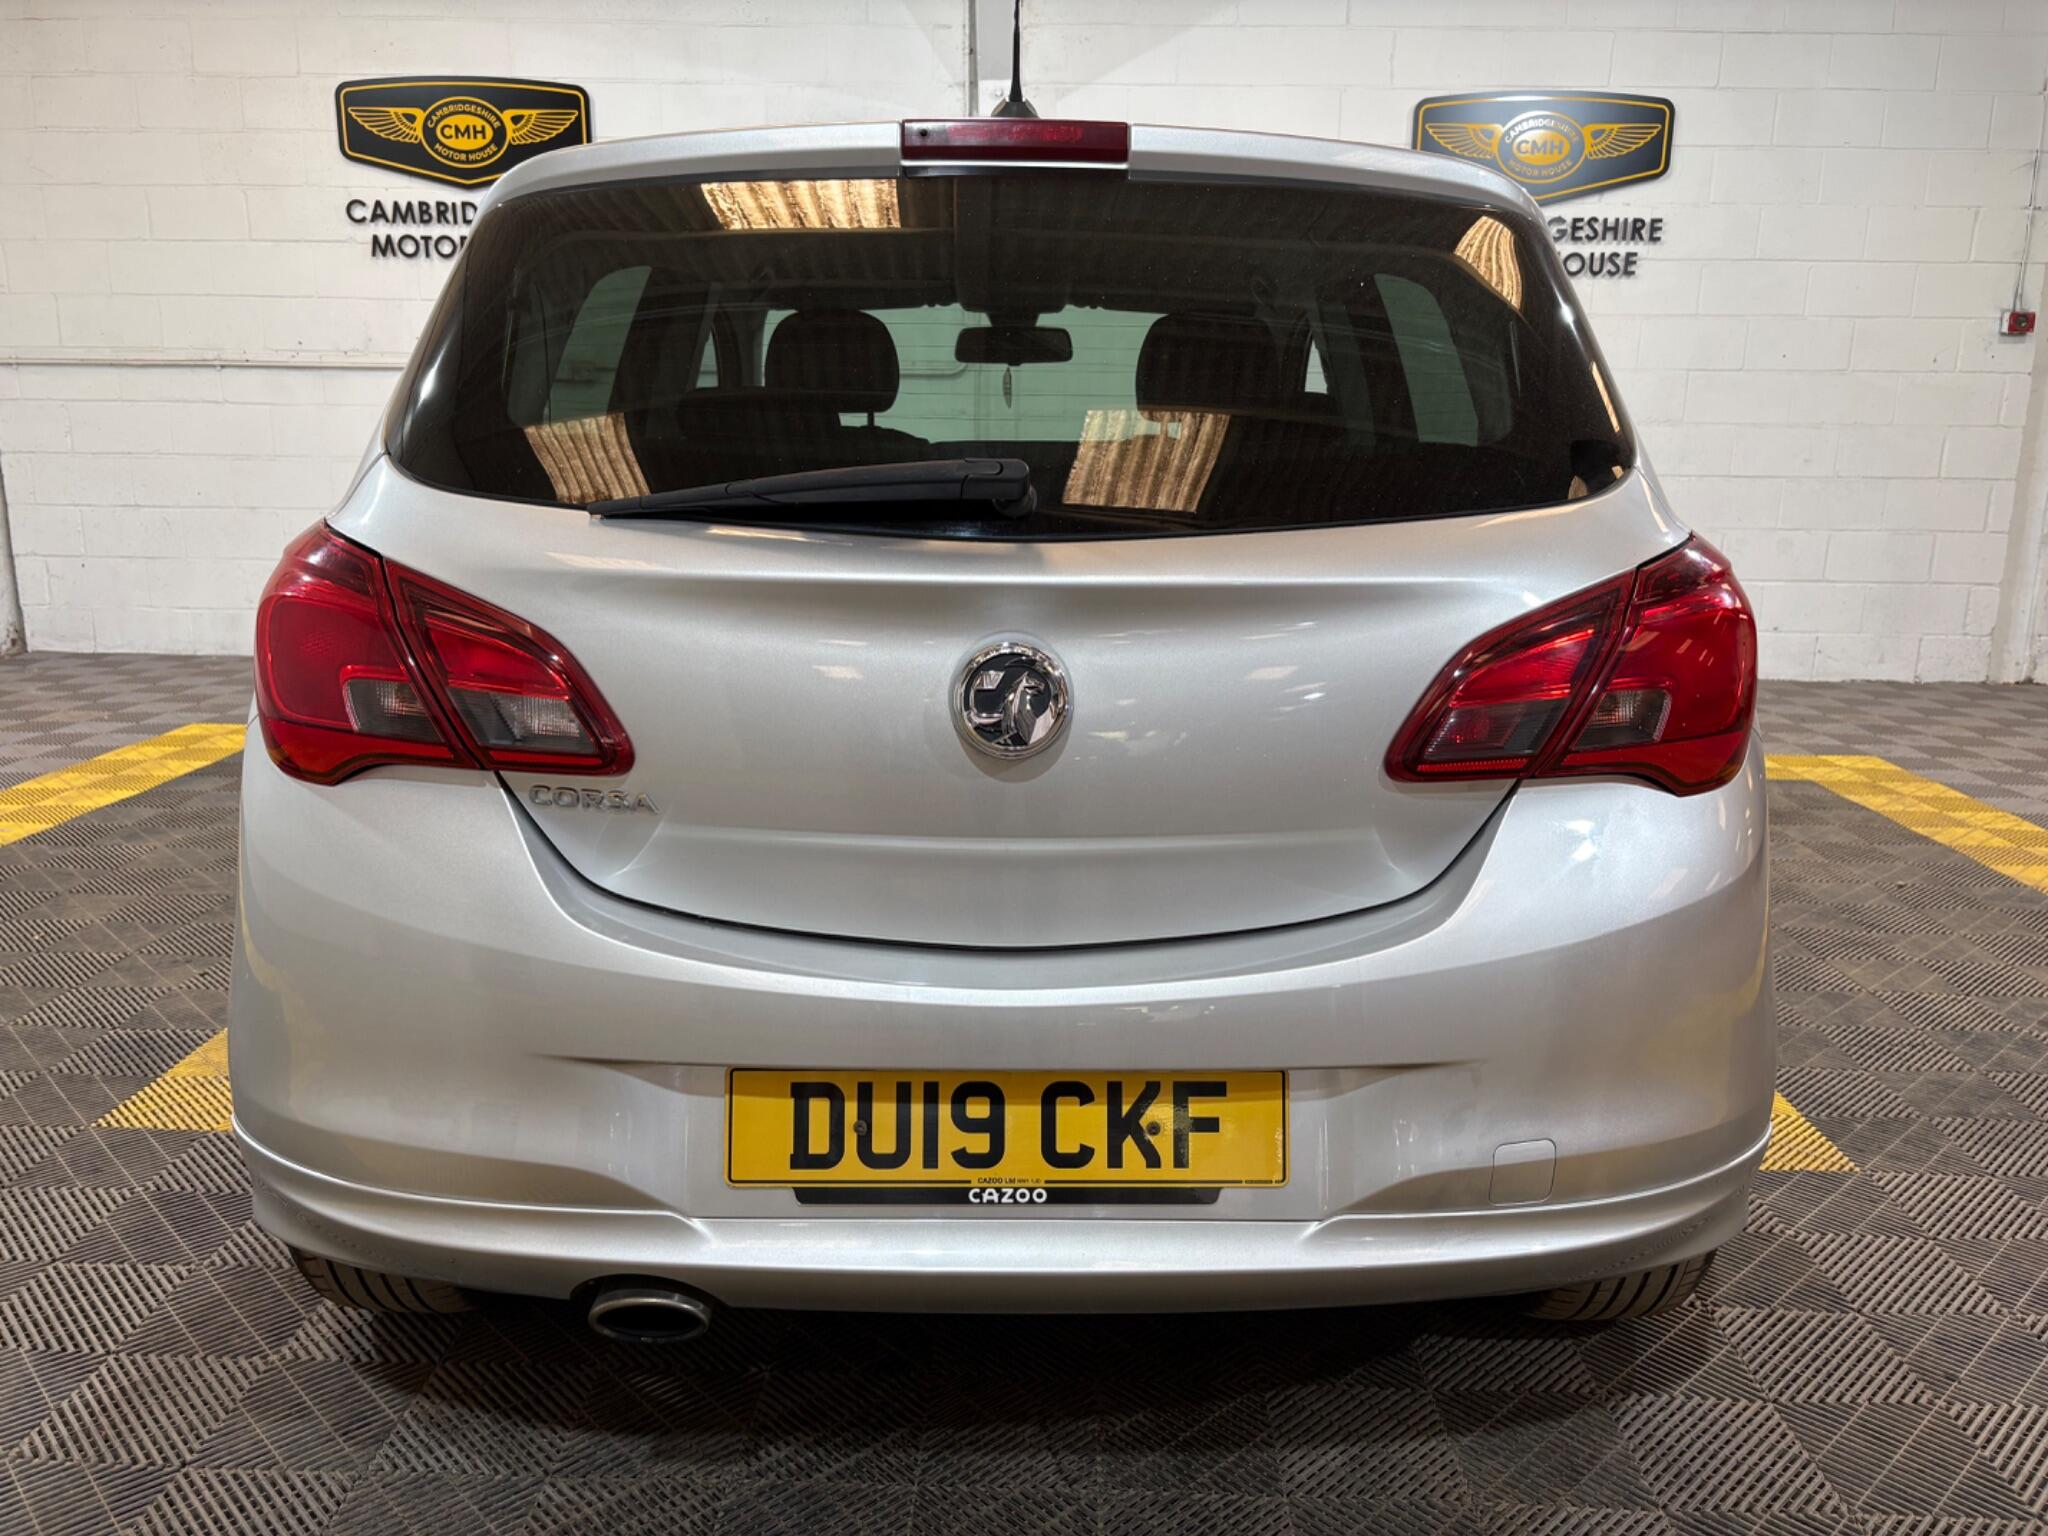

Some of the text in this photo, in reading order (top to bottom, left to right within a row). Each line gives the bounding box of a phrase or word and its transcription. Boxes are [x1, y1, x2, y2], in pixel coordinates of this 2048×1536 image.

[427, 103, 501, 128] CAMBRIDGESHIRE
[440, 124, 486, 139] CMH
[434, 143, 498, 161] MOTOR HOUSE
[1516, 138, 1565, 154] CMH
[1558, 252, 1638, 276] OUSE
[528, 784, 660, 815] CORSA
[789, 1079, 1228, 1170] DU19 CKF
[968, 1187, 1048, 1204] CAZOO
